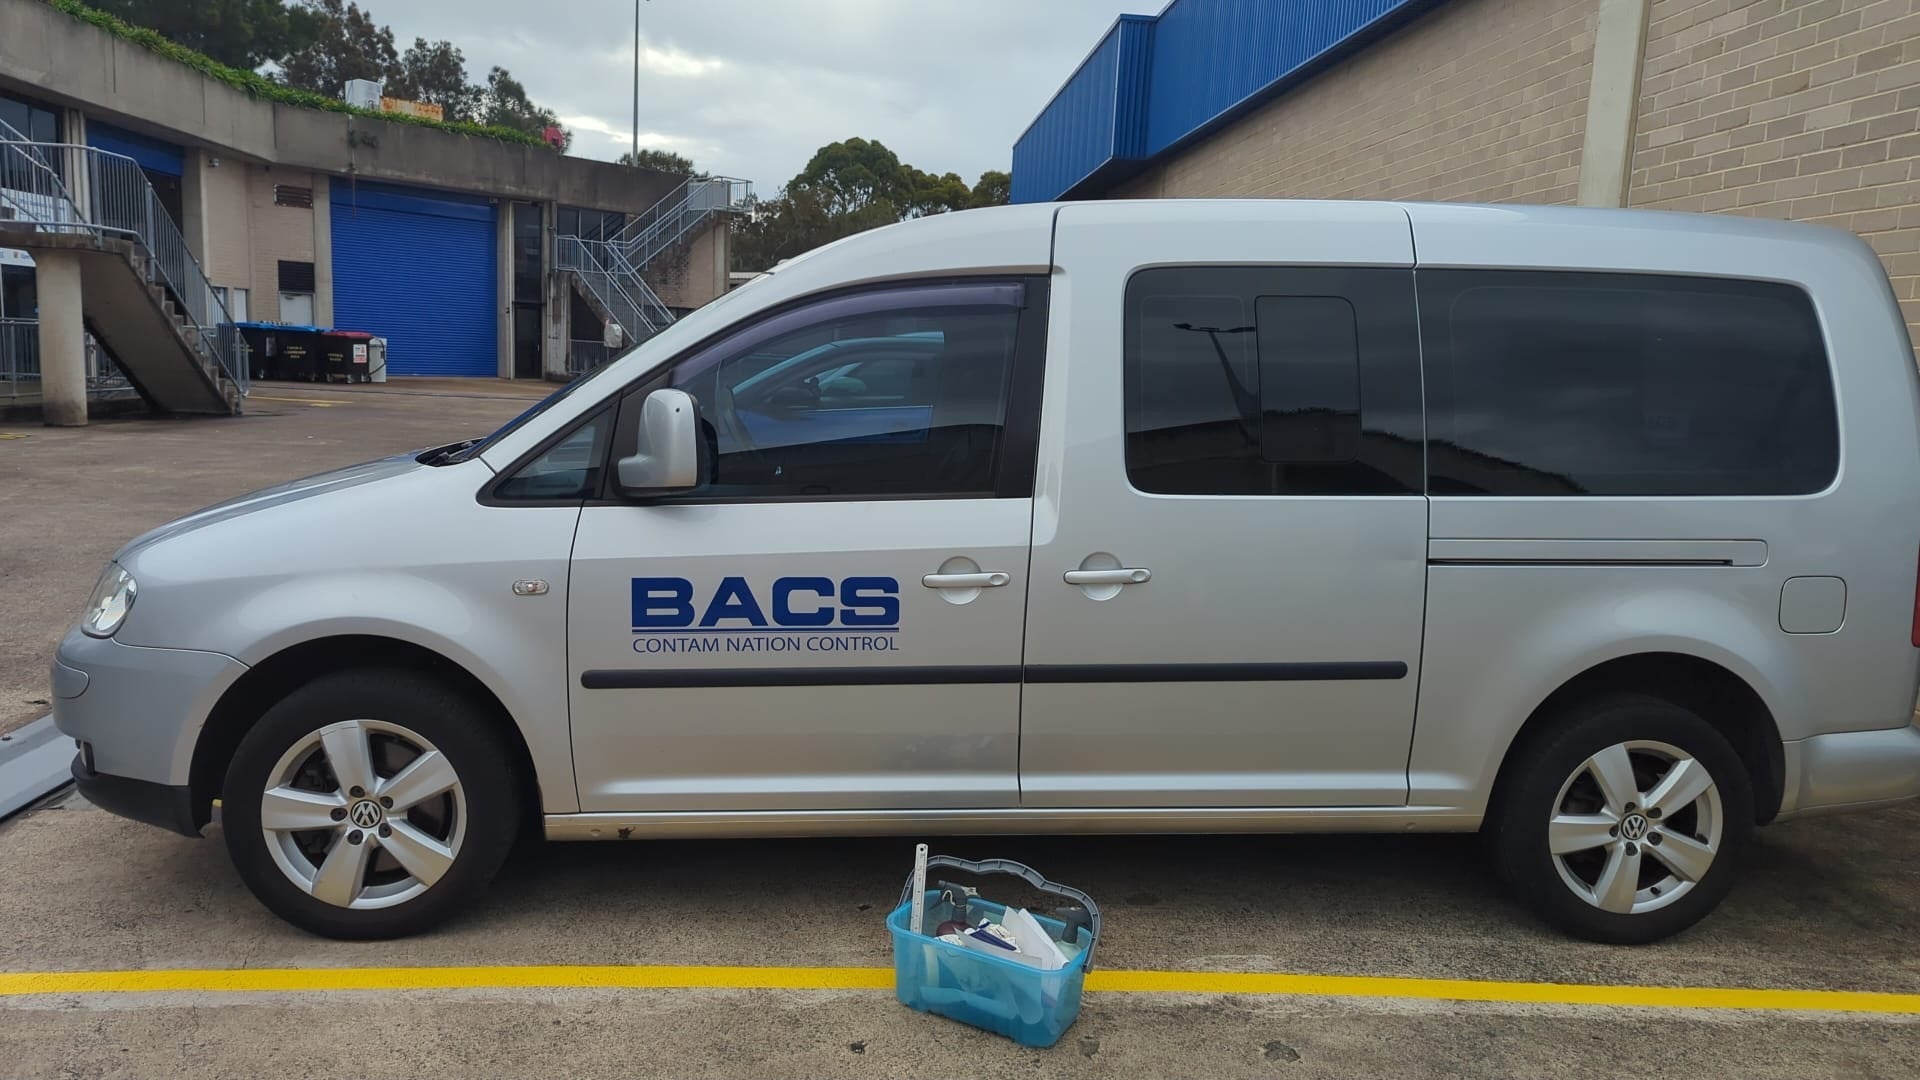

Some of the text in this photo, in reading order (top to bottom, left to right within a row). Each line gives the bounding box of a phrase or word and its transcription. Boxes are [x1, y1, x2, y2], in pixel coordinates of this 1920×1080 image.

[631, 577, 899, 626] BACS
[806, 636, 899, 651] CONTROL
[1621, 813, 1648, 840] VW
